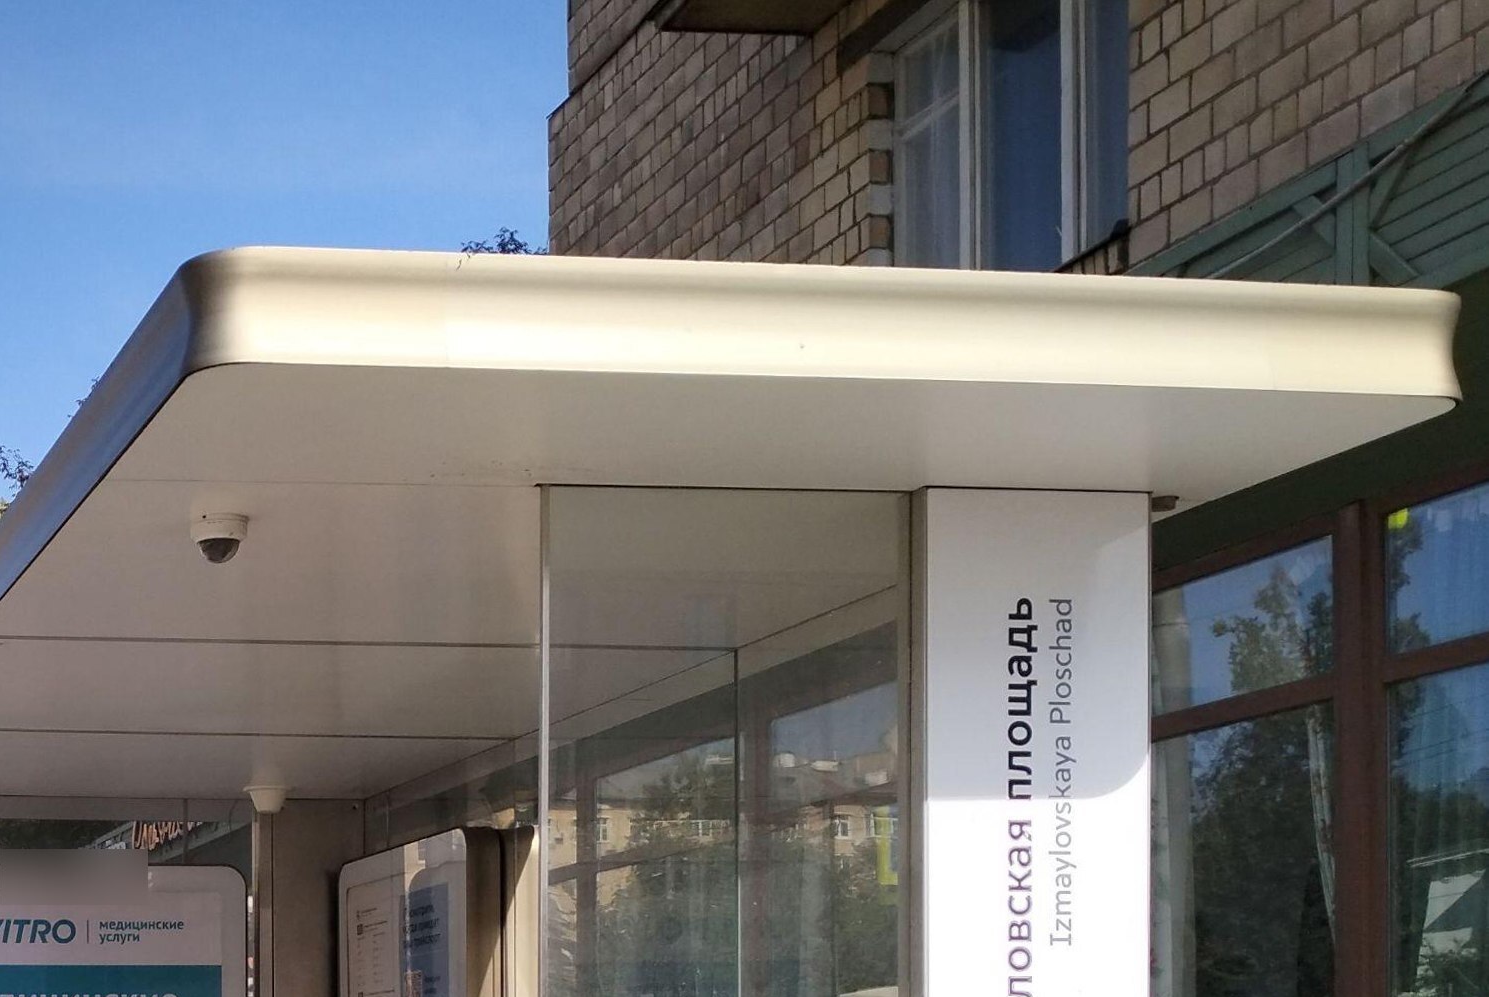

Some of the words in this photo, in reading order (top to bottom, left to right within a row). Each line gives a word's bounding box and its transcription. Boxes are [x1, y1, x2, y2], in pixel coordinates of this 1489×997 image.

[1007, 597, 1039, 800] площадь
[1048, 598, 1074, 723] Ploschad
[1048, 735, 1077, 947] Izmaylovskaya
[98, 919, 185, 932] медицинские
[98, 932, 141, 944] услуги
